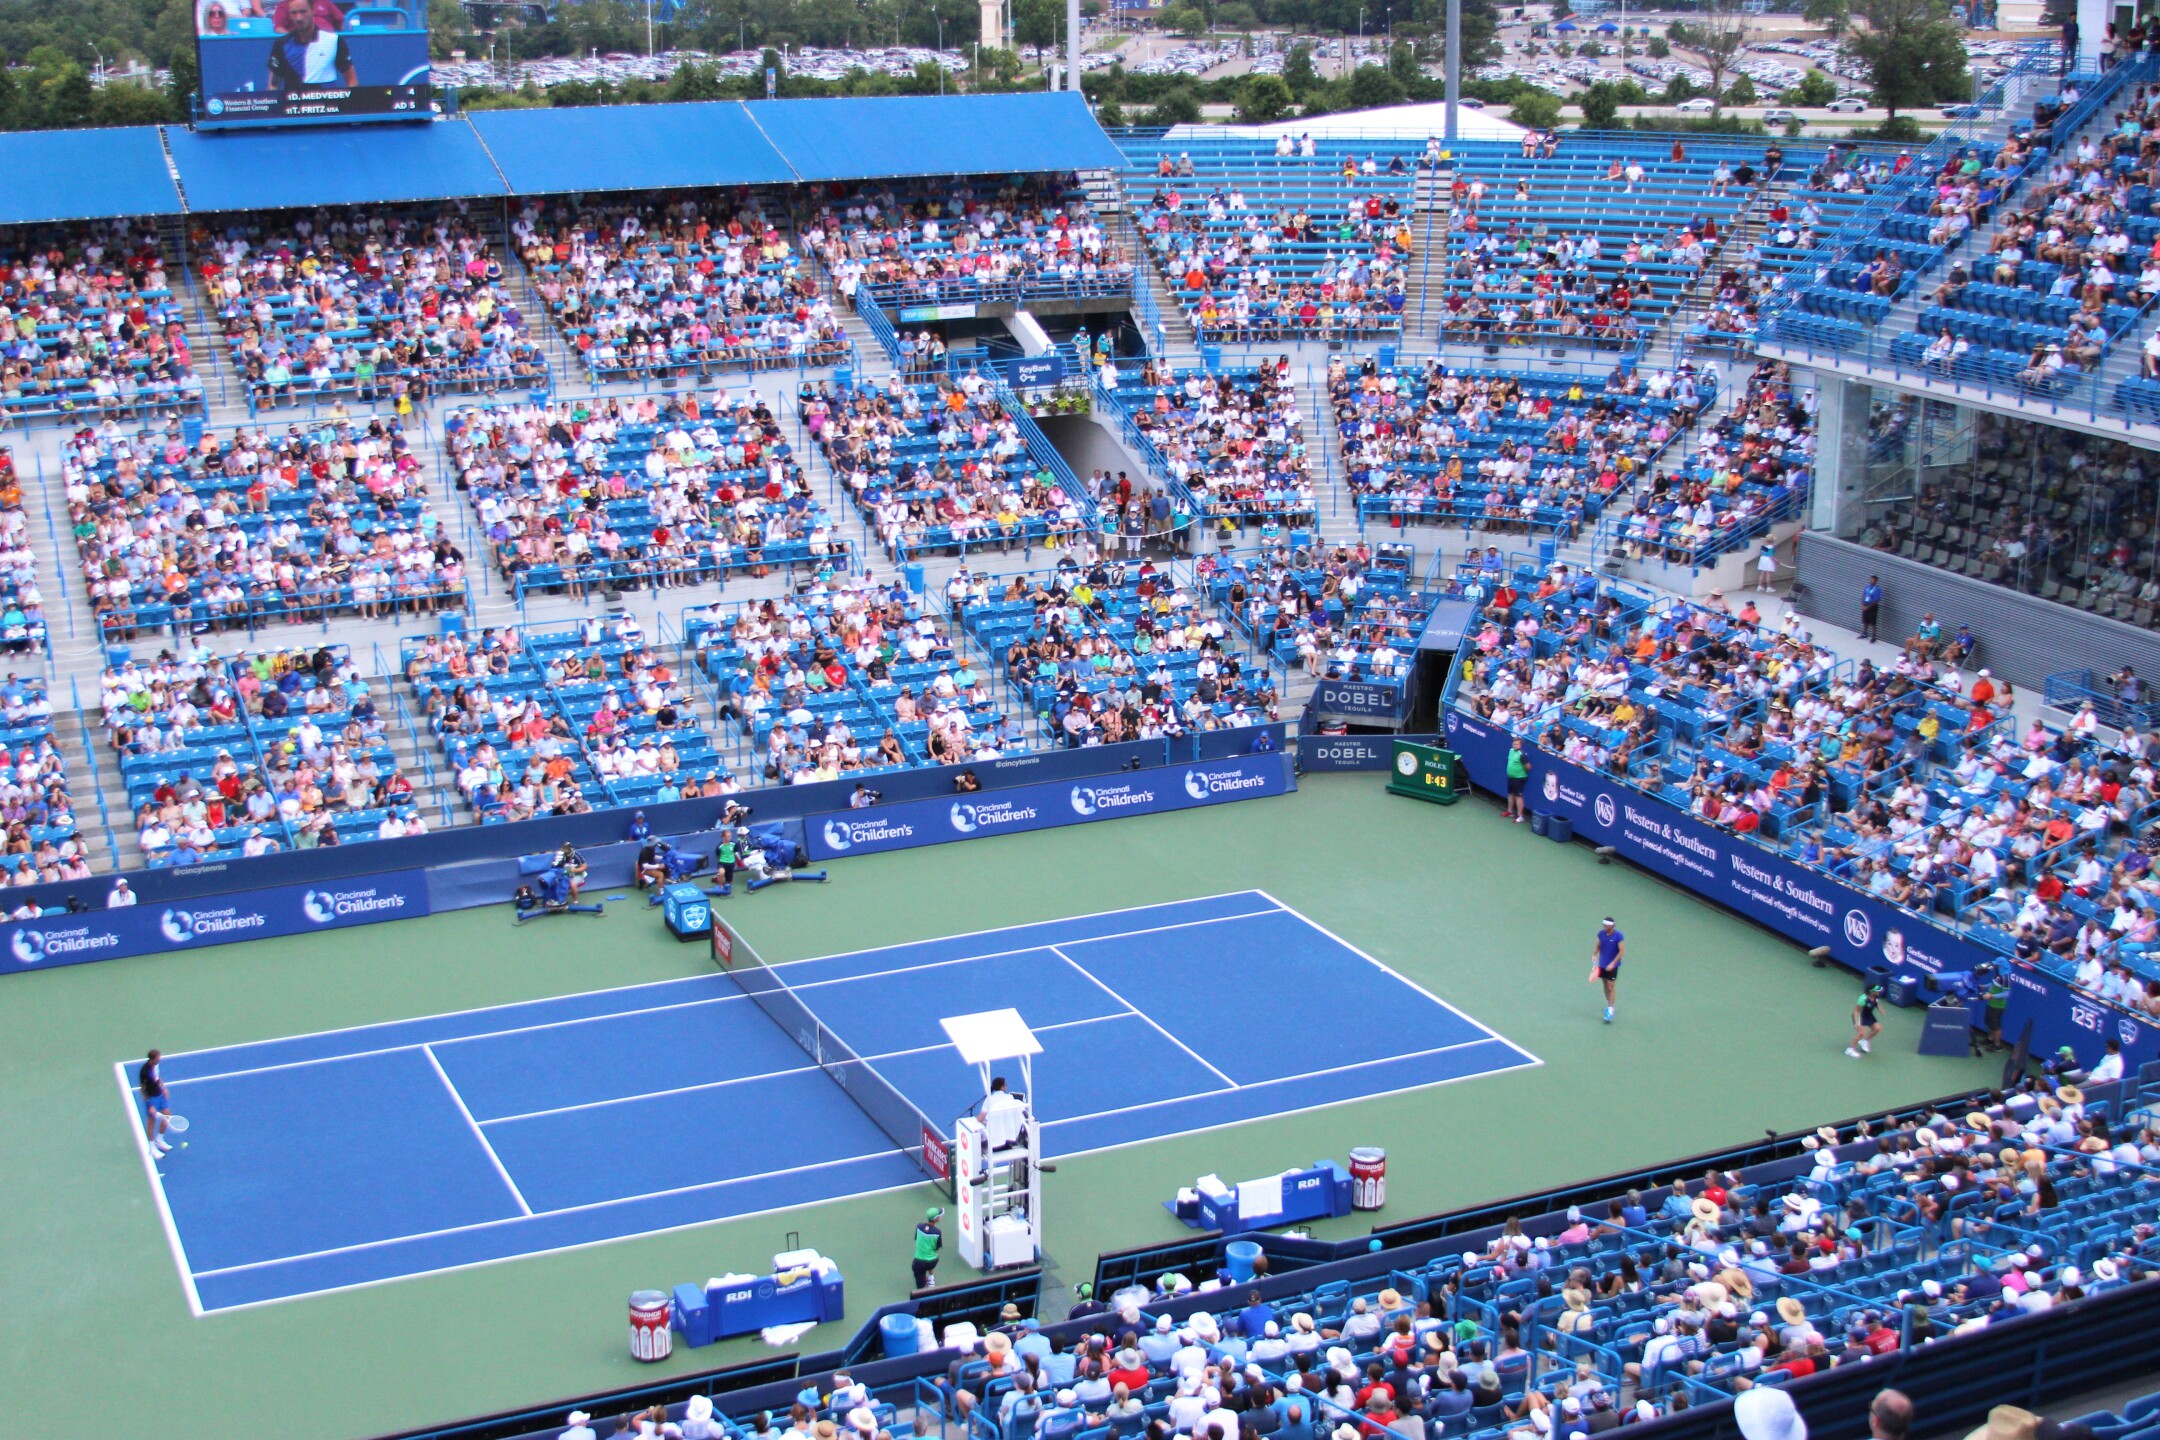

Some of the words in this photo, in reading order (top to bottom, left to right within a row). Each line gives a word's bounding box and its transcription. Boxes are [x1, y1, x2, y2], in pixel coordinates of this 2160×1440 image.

[302, 90, 351, 101] MEDVEDEV
[407, 87, 415, 96] 4
[224, 99, 246, 107] Western
[253, 98, 278, 106] Southern
[225, 105, 251, 113] Financial
[252, 105, 269, 113] Group
[393, 102, 407, 110] AD
[301, 105, 326, 114] FRITZ
[904, 311, 917, 319] TOP
[1019, 364, 1052, 374] KeyBank
[1324, 690, 1391, 707] DOBEL
[1317, 748, 1377, 759] DOBEL
[995, 756, 1040, 768] @cincytennis
[1424, 760, 1447, 770] ROLEX
[1208, 769, 1242, 781] Cincinnati
[1425, 773, 1447, 788] 0:43
[1096, 784, 1130, 796] Cincinnati
[1210, 775, 1265, 793] Children's
[1559, 785, 1575, 797] Gerber
[1097, 790, 1154, 809] Children's
[976, 801, 1012, 813] Cincinnati
[978, 806, 1037, 826] Children's
[851, 818, 888, 830] Cincinnati
[852, 824, 913, 843] Children's
[1624, 805, 1660, 834] Western
[1661, 824, 1671, 839] &
[1673, 828, 1716, 860] Southern
[1624, 829, 1633, 839] Put
[1642, 838, 1662, 853] financial
[1662, 848, 1685, 865] strength
[1685, 858, 1702, 873] behind
[173, 863, 227, 876] @cincytennis
[1731, 854, 1771, 886] Western
[1773, 875, 1783, 891] &
[1785, 880, 1833, 915] Southern
[334, 888, 376, 901] Cincinnati
[336, 894, 405, 914] Children's
[1731, 880, 1741, 890] Put
[1751, 889, 1774, 906] financial
[1774, 900, 1797, 919] strength
[1798, 911, 1818, 927] behind
[193, 907, 236, 919] Cincinnati
[194, 913, 266, 933] Children's
[45, 927, 89, 940] Cincinnati
[46, 933, 119, 953] Children's
[1906, 946, 1928, 961] Gerber
[2010, 973, 2047, 995] CINNATI
[2071, 1006, 2096, 1030] 125
[924, 1132, 948, 1164] Emirates
[1297, 1177, 1320, 1190] RDI
[1203, 1204, 1216, 1221] RDI
[725, 1289, 753, 1303] RDI
